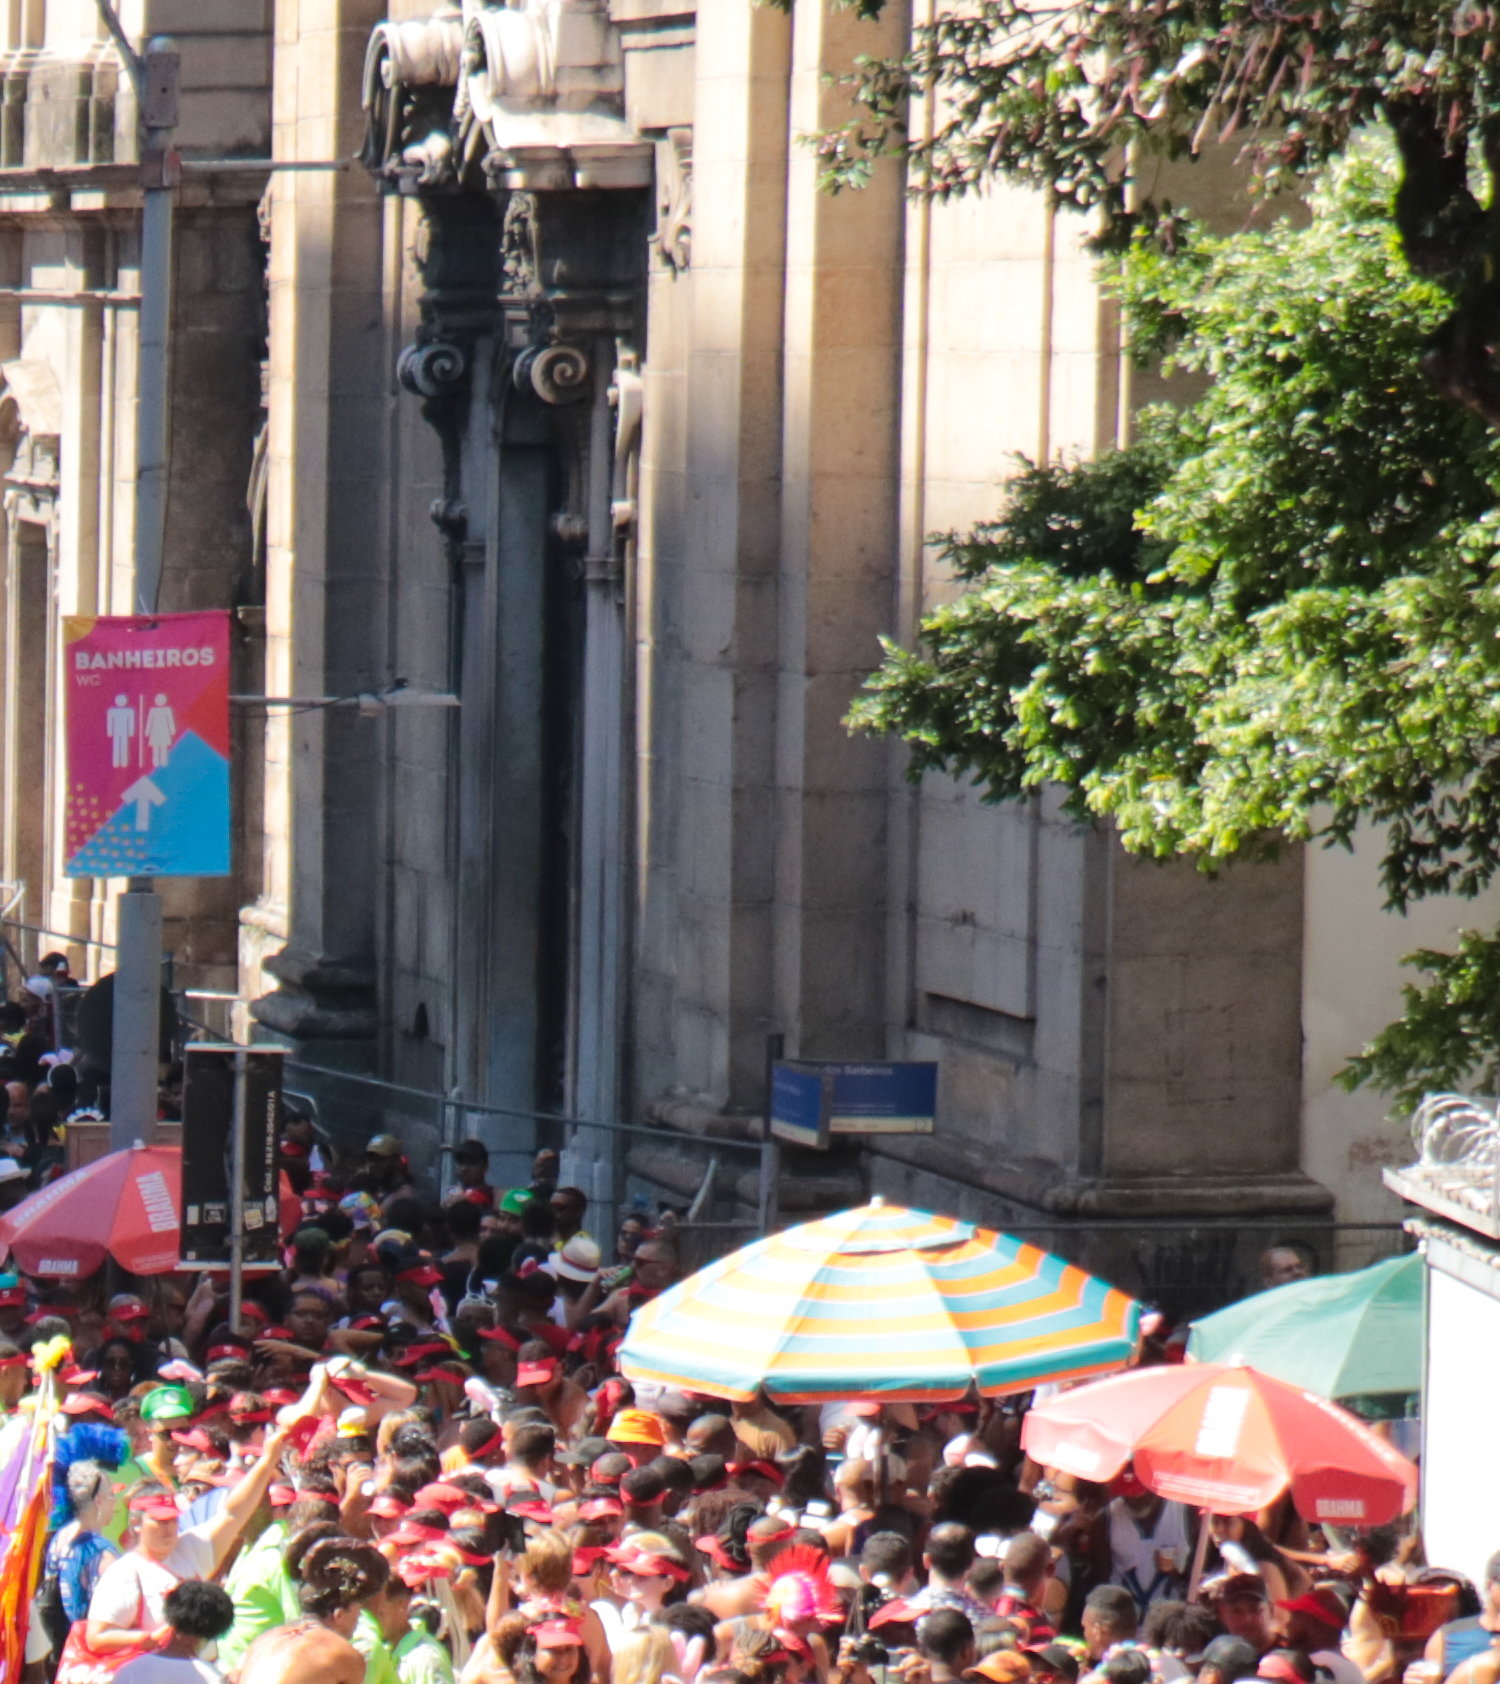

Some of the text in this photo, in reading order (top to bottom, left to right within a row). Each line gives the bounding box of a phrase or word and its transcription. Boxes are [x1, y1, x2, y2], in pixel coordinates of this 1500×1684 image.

[75, 648, 215, 670] BANHEIROS
[76, 674, 100, 687] WC
[135, 1171, 181, 1233] BRAHMA
[1315, 1498, 1366, 1519] BRAHMA
